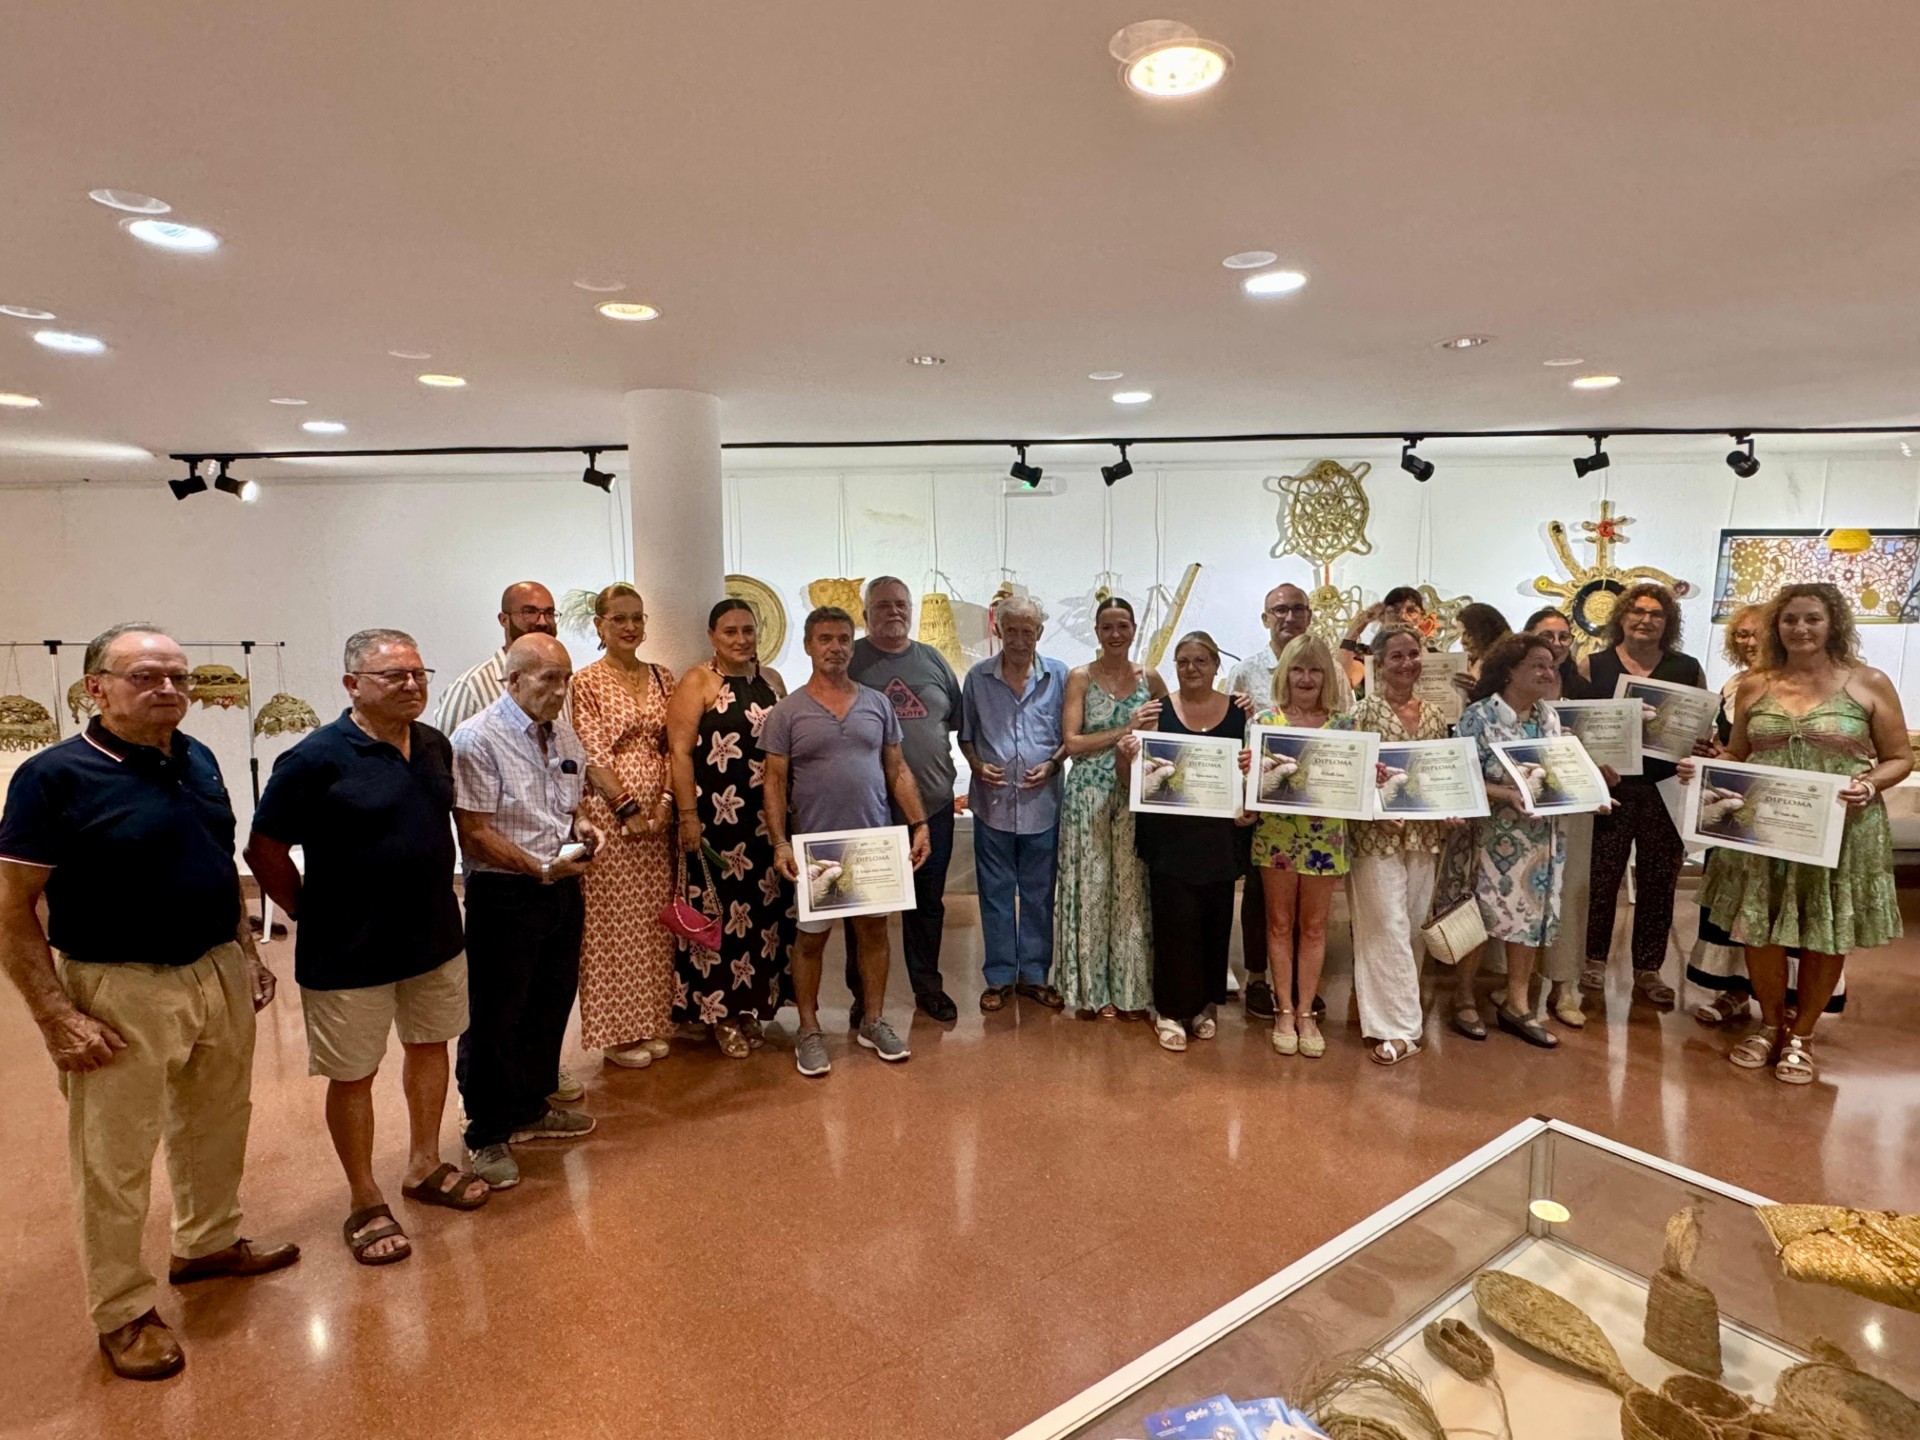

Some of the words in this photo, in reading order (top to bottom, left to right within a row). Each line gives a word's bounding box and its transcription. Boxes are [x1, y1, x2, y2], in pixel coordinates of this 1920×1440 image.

[1189, 761, 1222, 769] DIPLOMA
[1314, 757, 1353, 766] DIPLOMA
[1765, 796, 1812, 808] DIPLOMA
[856, 855, 890, 863] DIPLOMA
